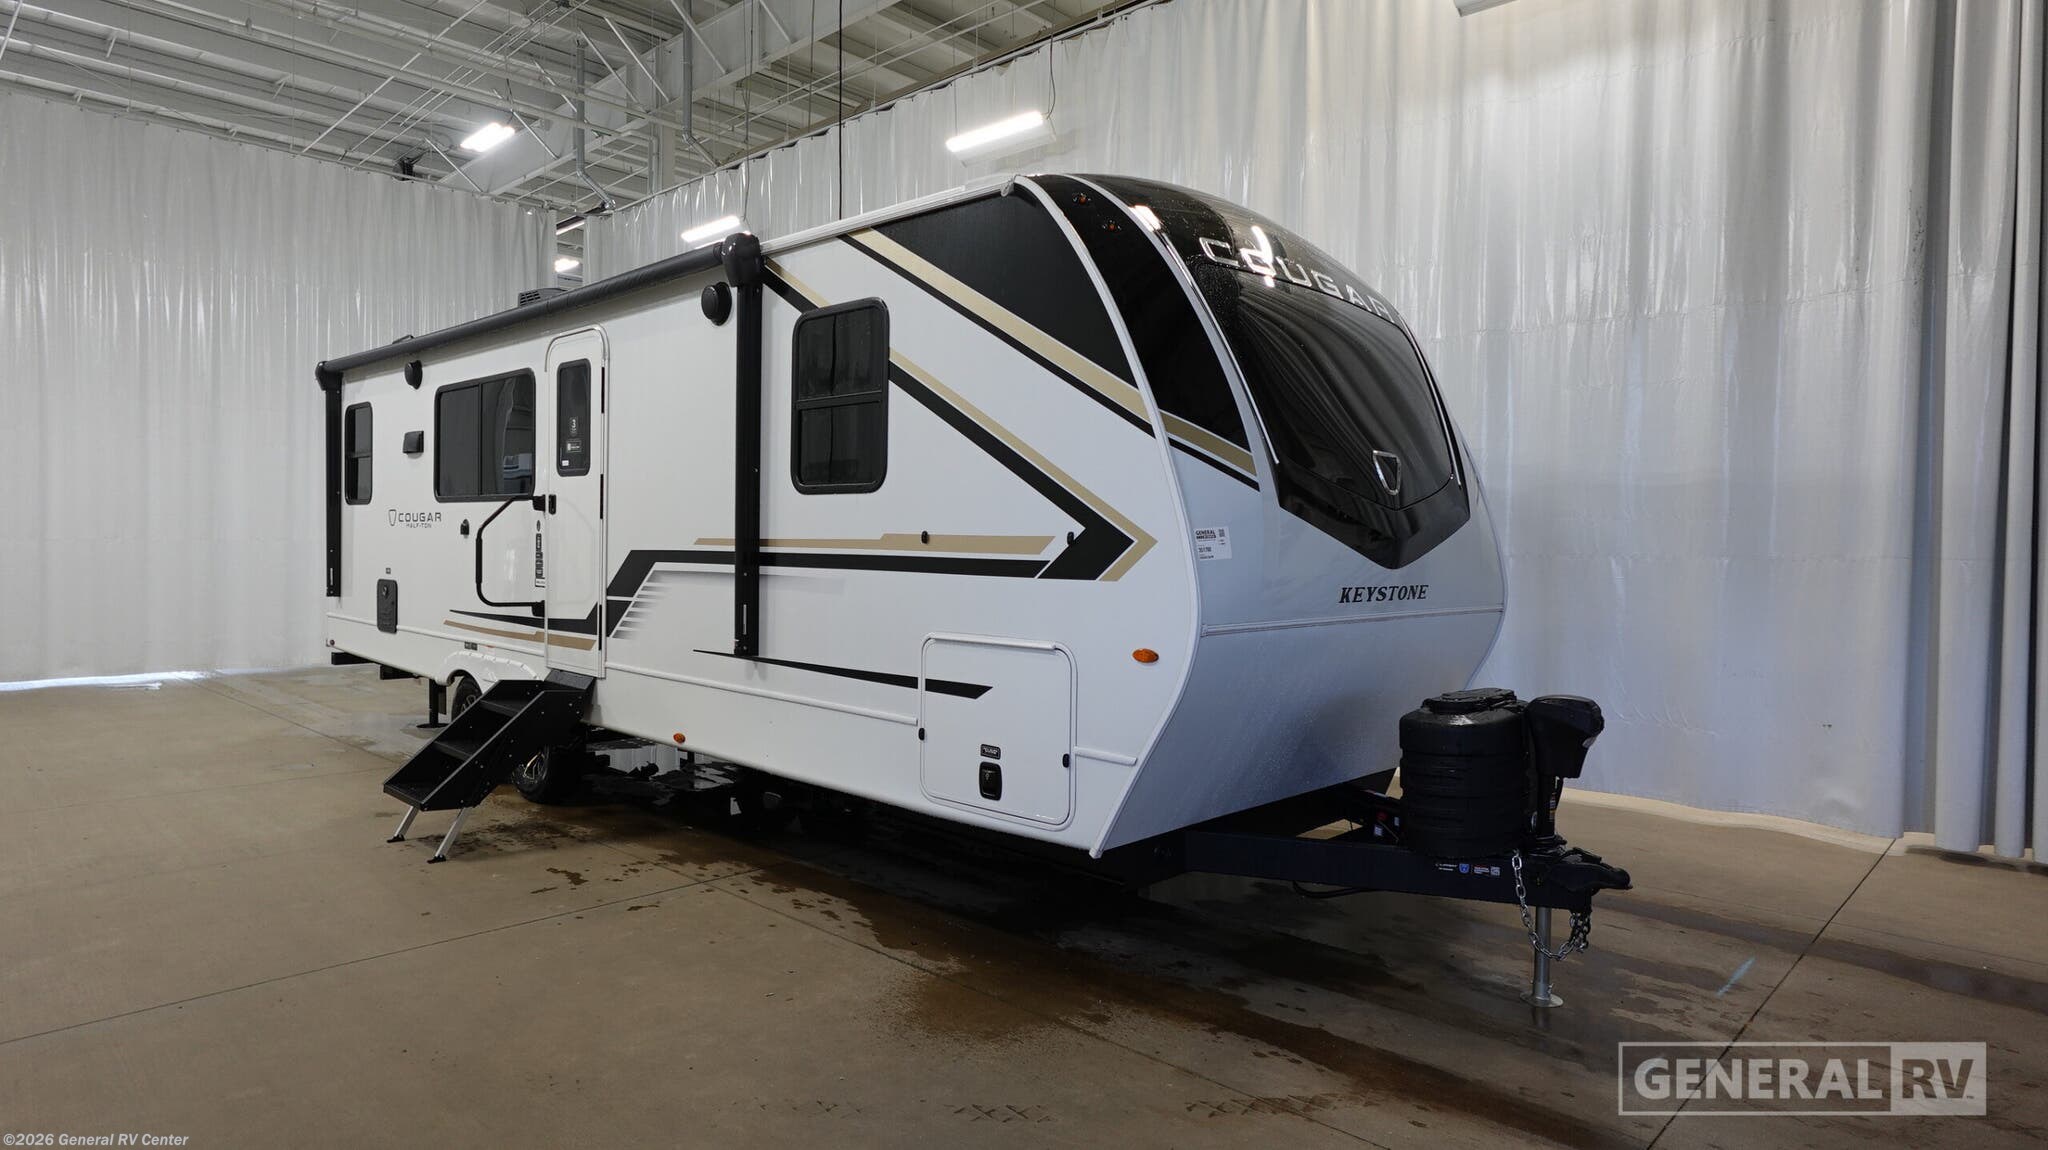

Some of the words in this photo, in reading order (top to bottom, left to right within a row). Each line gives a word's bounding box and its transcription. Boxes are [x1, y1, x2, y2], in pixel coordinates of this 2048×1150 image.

[1199, 236, 1395, 324] COUGAR
[398, 512, 442, 522] COUGAR
[1339, 584, 1429, 604] KEYSTONE
